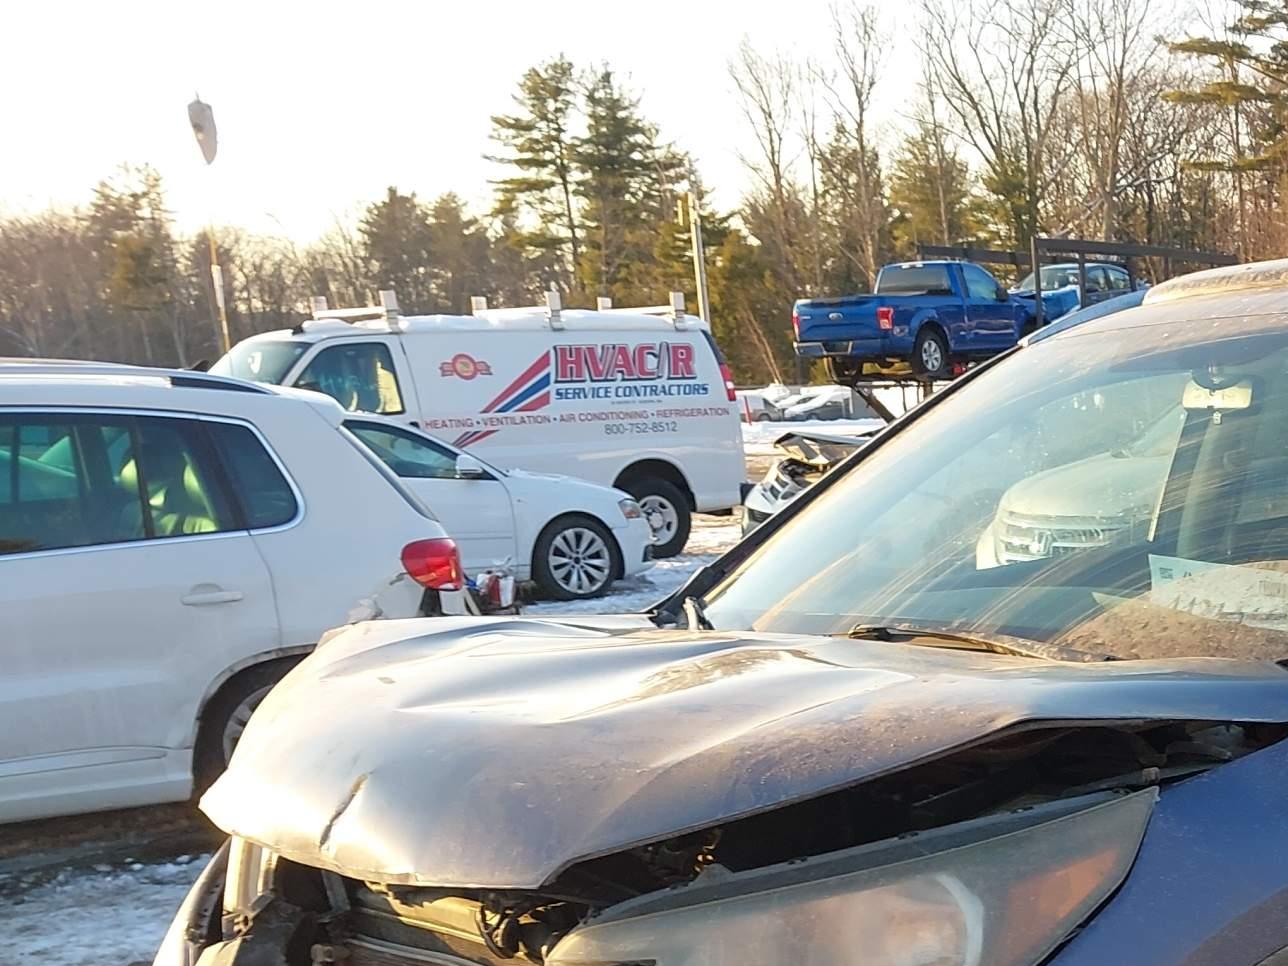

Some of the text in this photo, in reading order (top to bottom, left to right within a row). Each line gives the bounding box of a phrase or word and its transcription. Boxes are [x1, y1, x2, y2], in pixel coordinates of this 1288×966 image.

[554, 342, 697, 383] HVAC/R
[555, 384, 709, 400] SERVICE CONTRACTORS
[425, 407, 730, 429] HEATING VENTILATION AIR CONDITIONING REFRIGERATION
[604, 421, 678, 435] 800-752-8512
